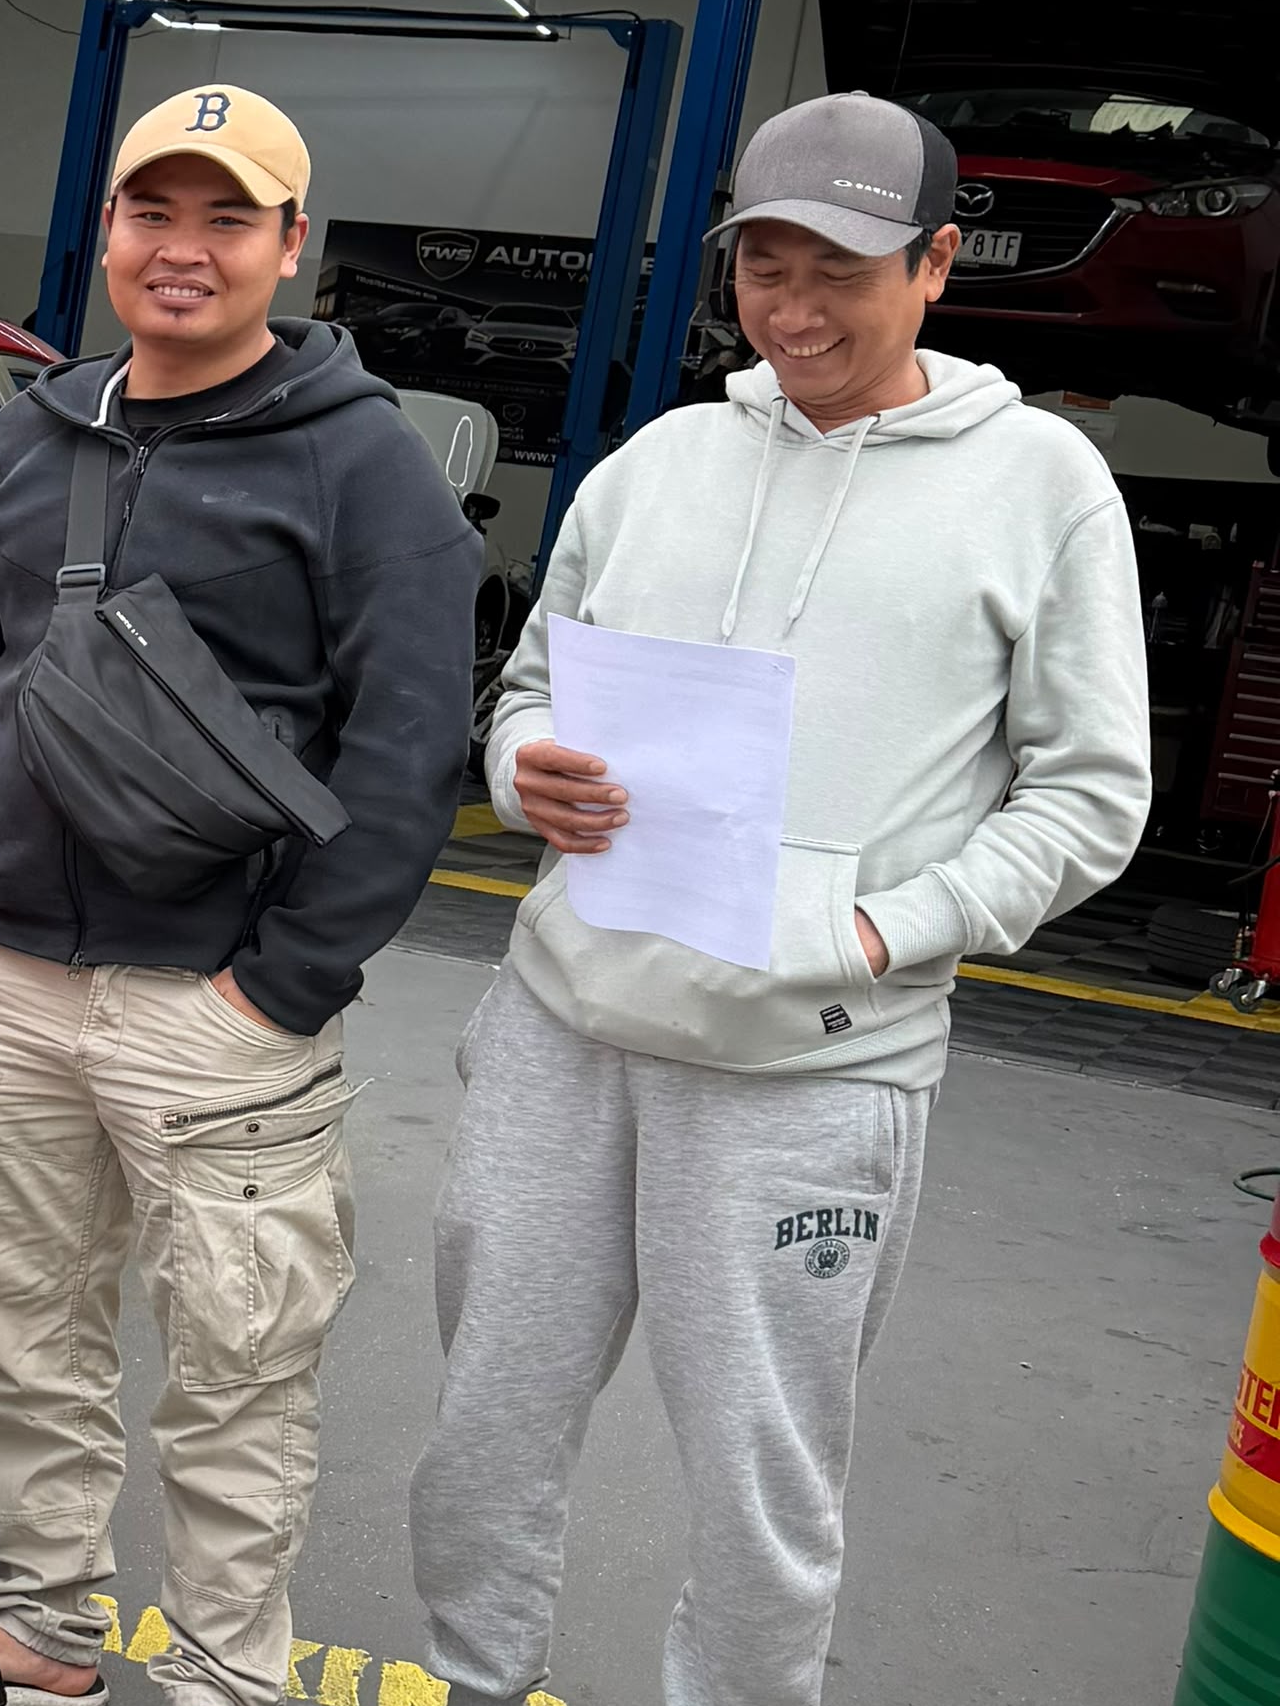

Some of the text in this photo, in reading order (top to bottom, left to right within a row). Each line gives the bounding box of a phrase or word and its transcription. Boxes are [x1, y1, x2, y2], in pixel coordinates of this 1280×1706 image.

[185, 92, 231, 131] B
[420, 245, 472, 263] TWS
[774, 1207, 879, 1251] BERLIN
